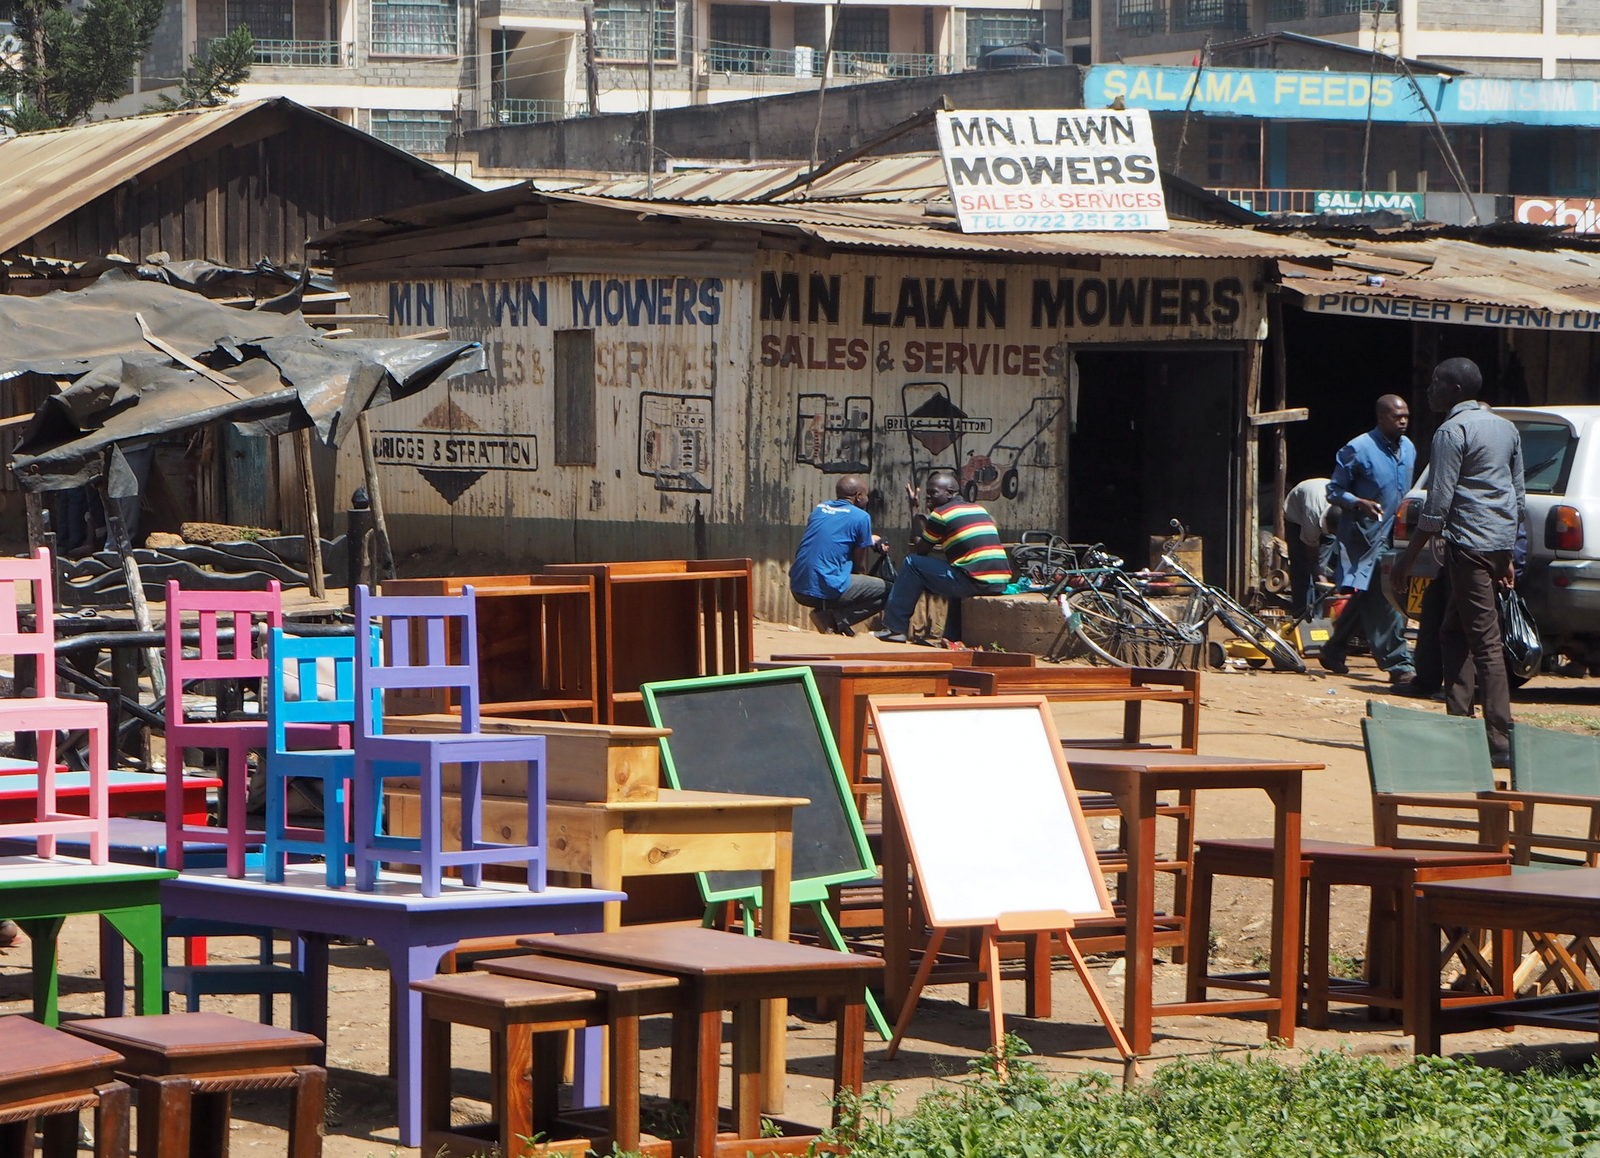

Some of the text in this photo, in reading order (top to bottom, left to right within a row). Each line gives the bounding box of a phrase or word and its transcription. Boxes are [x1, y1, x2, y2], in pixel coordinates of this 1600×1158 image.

[1104, 70, 1393, 107] SALAMA FEEDS
[1029, 115, 1136, 146] LAWN
[950, 155, 1156, 186] MOWERS
[960, 192, 1162, 211] SALES & SERVICES
[1317, 193, 1417, 209] SALAMA
[1517, 199, 1600, 233] Chi
[971, 213, 1149, 229] TEL 0722 251 231
[389, 278, 724, 327] MN LAWN MOWERS
[760, 270, 1244, 329] MN LAWN MOWERS
[1318, 293, 1450, 320] PIONEER
[760, 334, 1065, 377] SALES & SERVICES
[374, 437, 425, 460] BRIGGS
[446, 439, 530, 465] STRATTON
